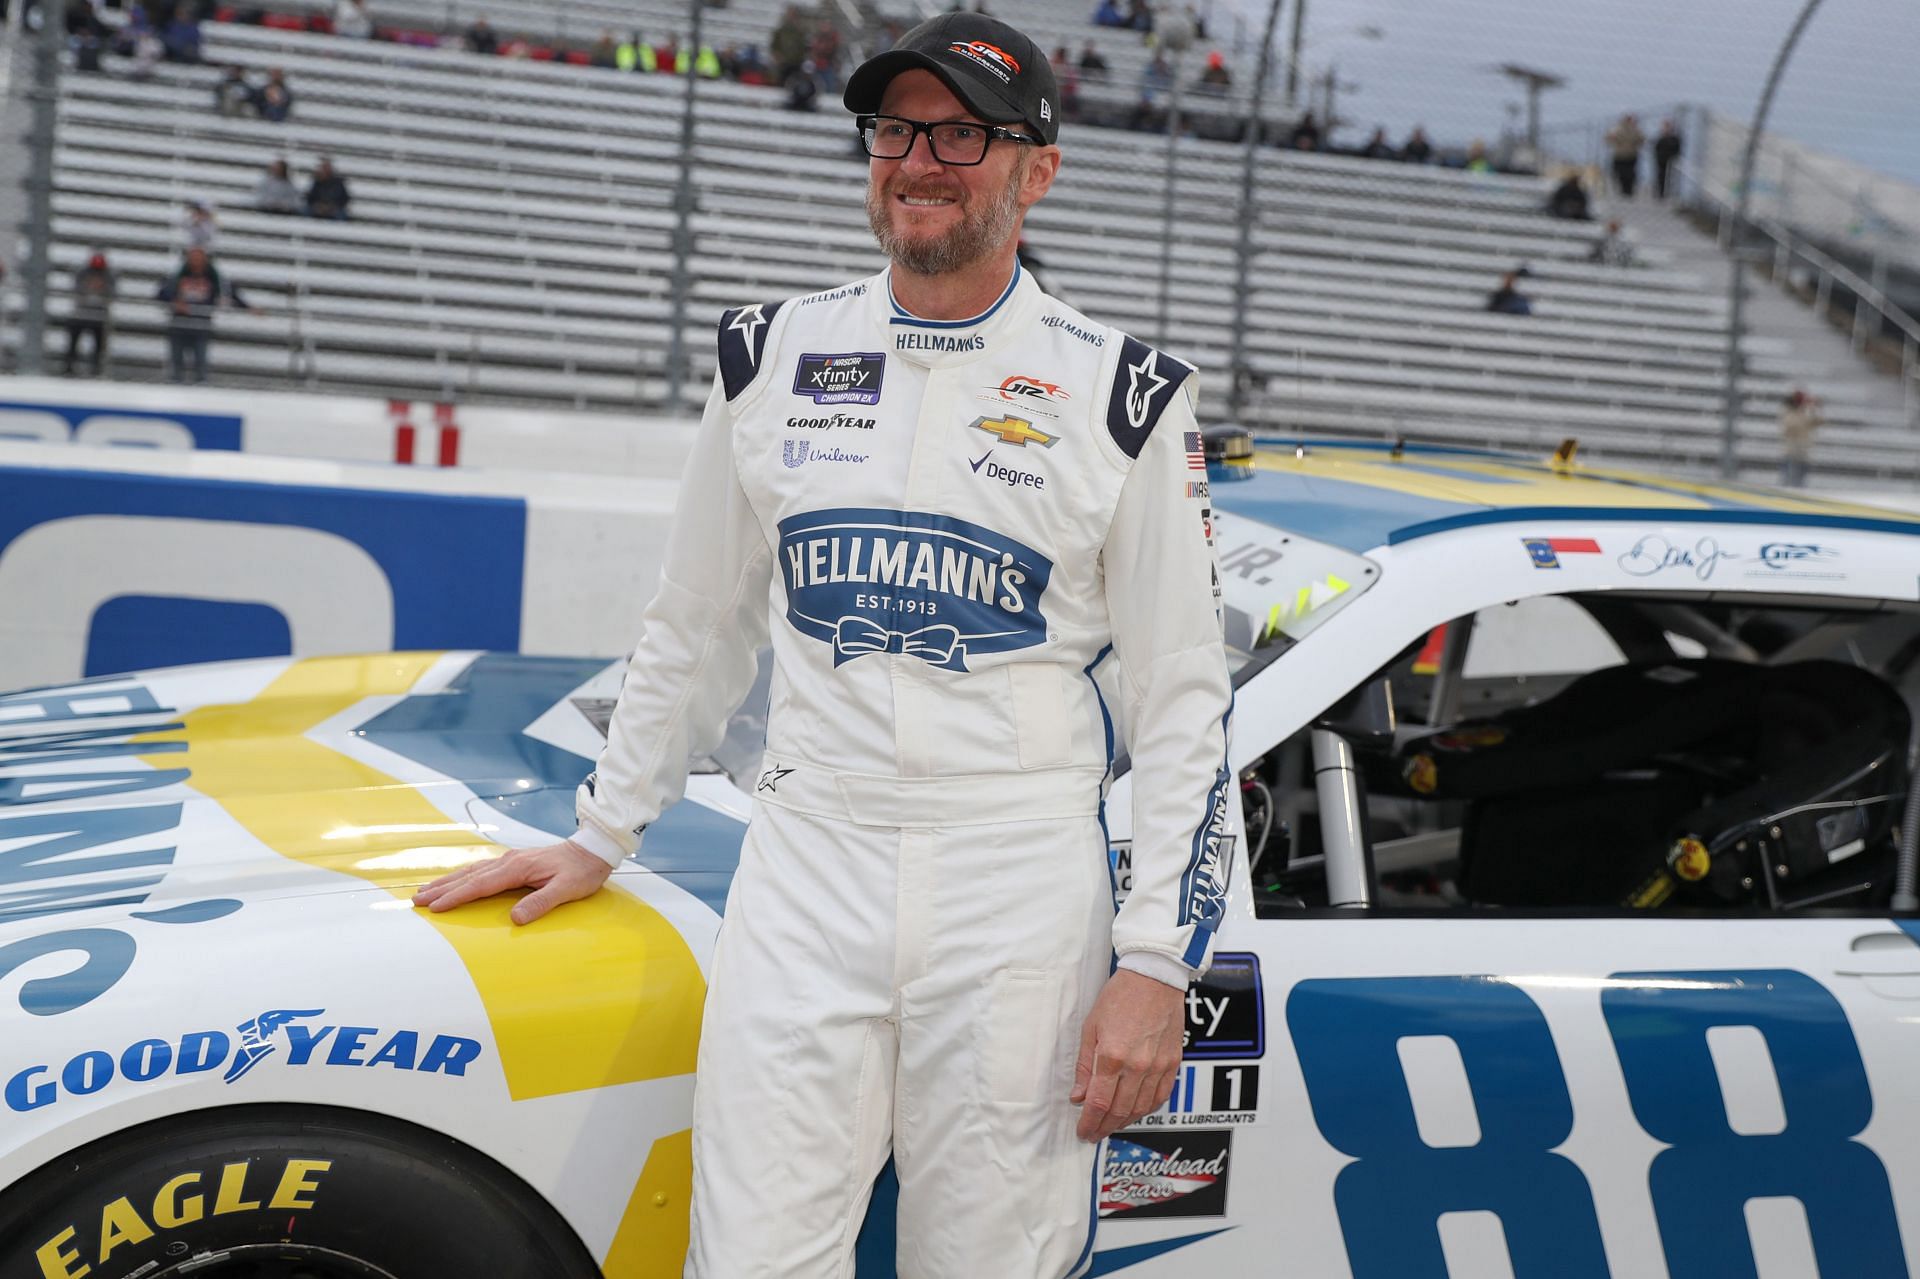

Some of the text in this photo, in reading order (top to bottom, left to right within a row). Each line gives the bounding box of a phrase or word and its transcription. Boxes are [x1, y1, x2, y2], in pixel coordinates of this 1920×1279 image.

[801, 284, 869, 306] HELLMANN'S
[1040, 314, 1105, 348] HELLMANN'S
[896, 333, 986, 353] HELLMANN'S
[833, 357, 862, 367] NASCAR
[811, 366, 870, 388] xfinity
[826, 383, 850, 392] SERIES
[820, 393, 874, 403] CHAMPION 2X
[809, 447, 870, 463] Unilever
[986, 462, 1045, 490] Degree
[786, 536, 1026, 614] HELLMANN'S
[1146, 1115, 1165, 1125] OIL
[1169, 1115, 1177, 1125] &
[1181, 1113, 1256, 1125] LUBRICANTS
[1285, 968, 1912, 1279] 88
[1105, 1146, 1228, 1178] rrowhead
[1109, 1175, 1175, 1203] Brass
[35, 1159, 332, 1279] EAGLE
